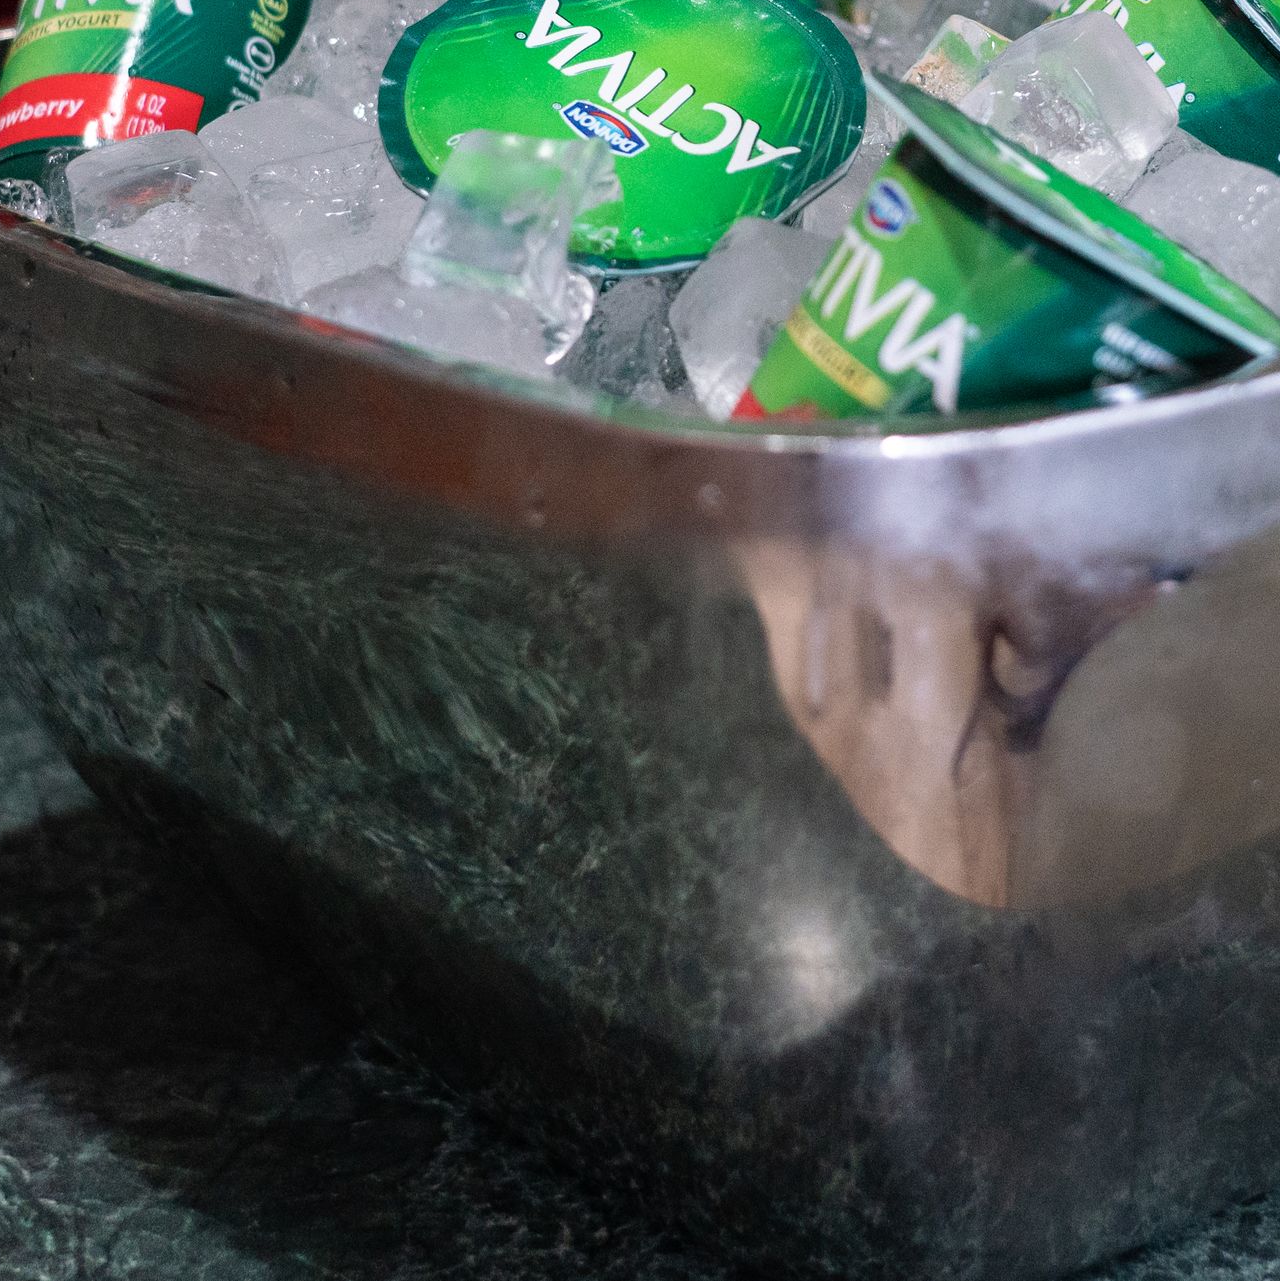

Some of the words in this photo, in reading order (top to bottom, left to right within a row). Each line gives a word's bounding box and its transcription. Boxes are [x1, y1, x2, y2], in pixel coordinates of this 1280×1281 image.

[57, 13, 122, 31] YOGURT
[136, 92, 148, 112] 4
[148, 94, 168, 117] OZ
[568, 106, 638, 153] DANNON
